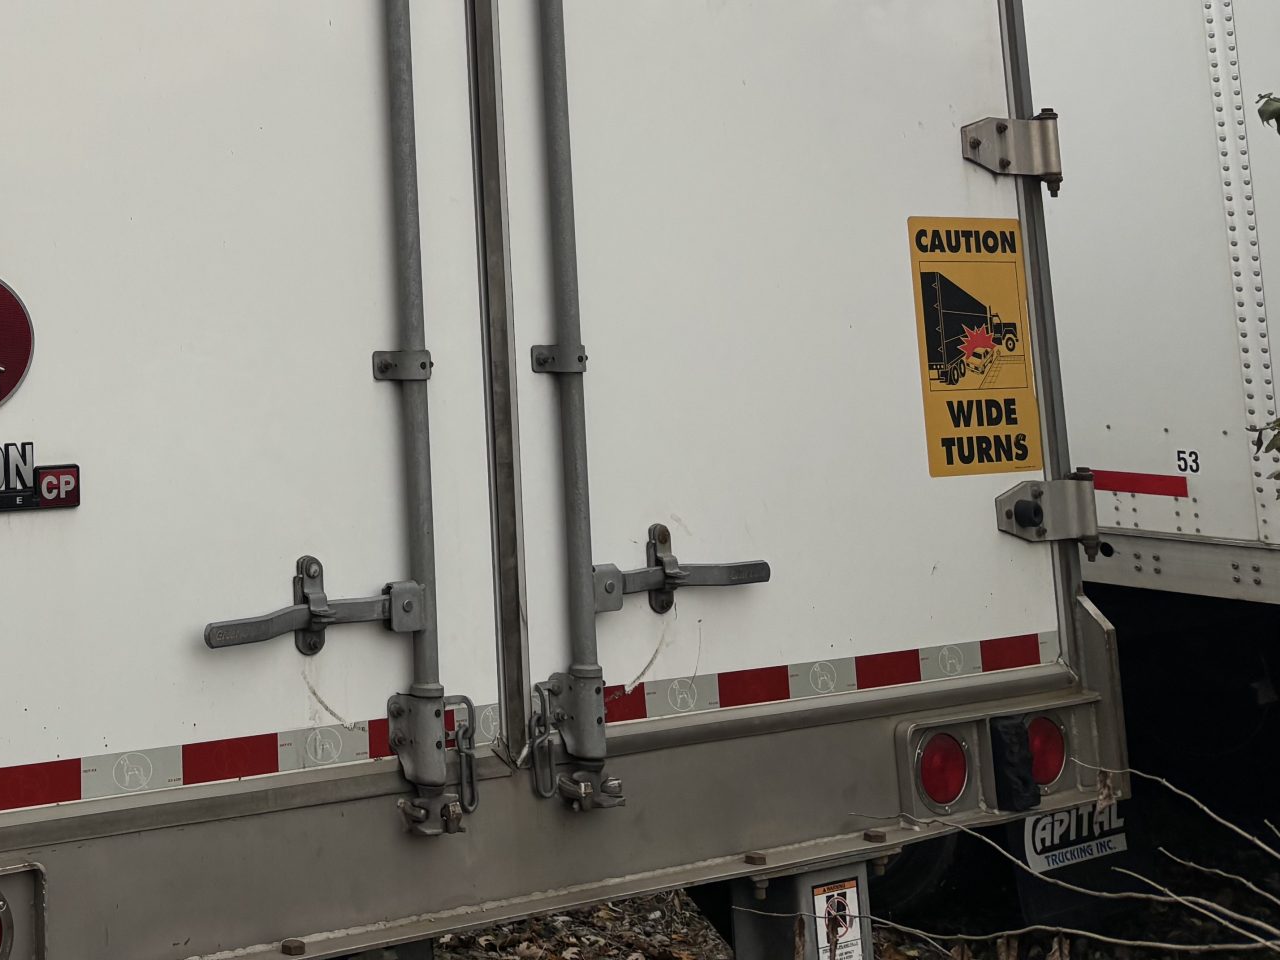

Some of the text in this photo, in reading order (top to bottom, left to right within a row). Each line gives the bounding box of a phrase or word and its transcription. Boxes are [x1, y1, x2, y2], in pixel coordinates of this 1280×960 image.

[915, 229, 1016, 254] CAUTION
[947, 398, 1018, 428] WIDE
[941, 433, 1028, 465] TURNS
[1176, 450, 1200, 473] 53
[40, 474, 75, 500] CP
[1024, 800, 1125, 873] CAPITAL
[1044, 840, 1117, 867] TRUCKING INC.
